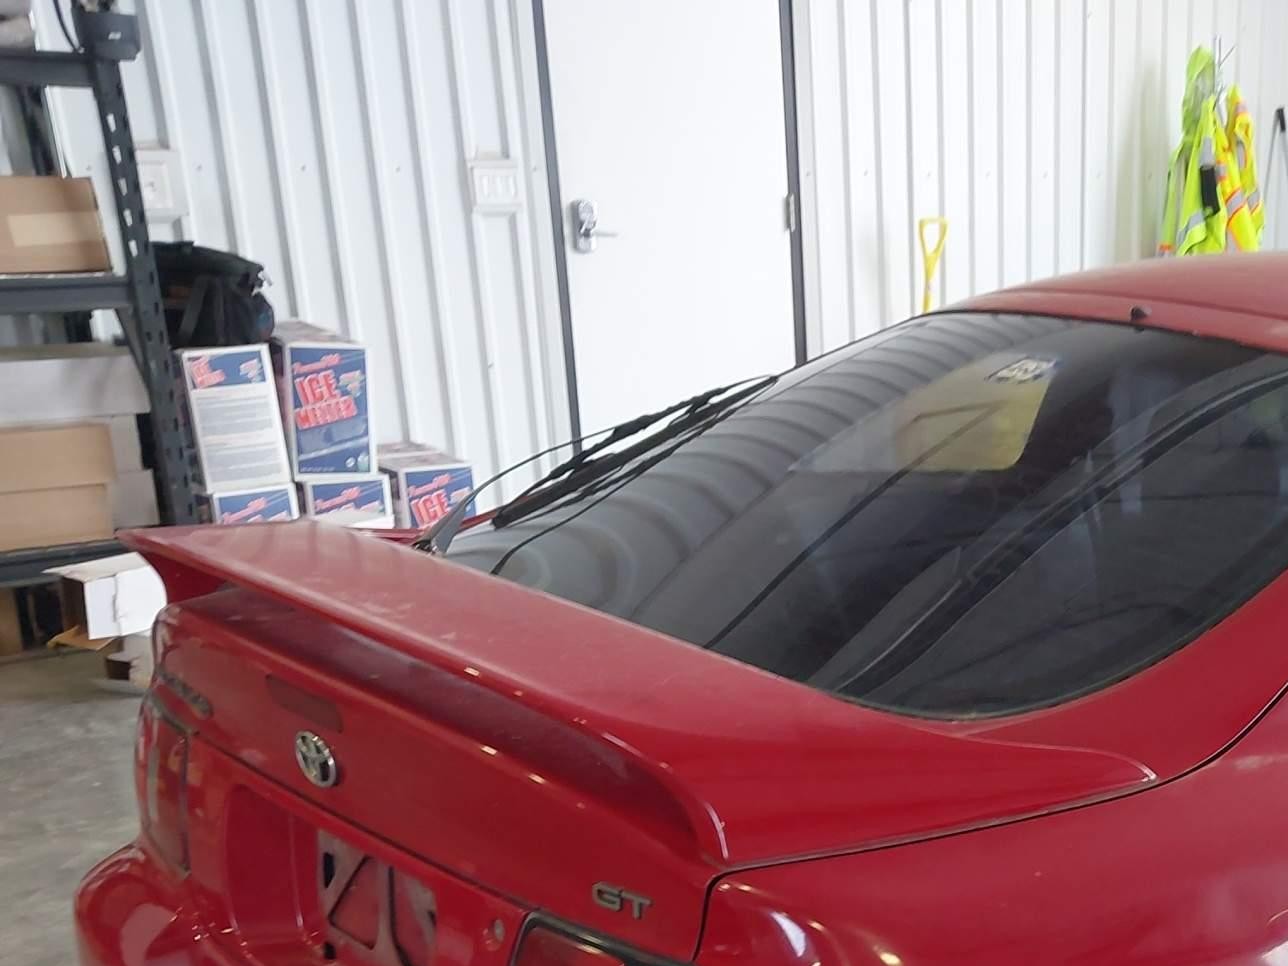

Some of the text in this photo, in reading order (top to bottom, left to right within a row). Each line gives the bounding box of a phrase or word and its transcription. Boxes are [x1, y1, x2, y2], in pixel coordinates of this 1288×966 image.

[295, 370, 341, 406] ICE
[410, 489, 451, 529] ICE
[592, 881, 652, 920] GT
